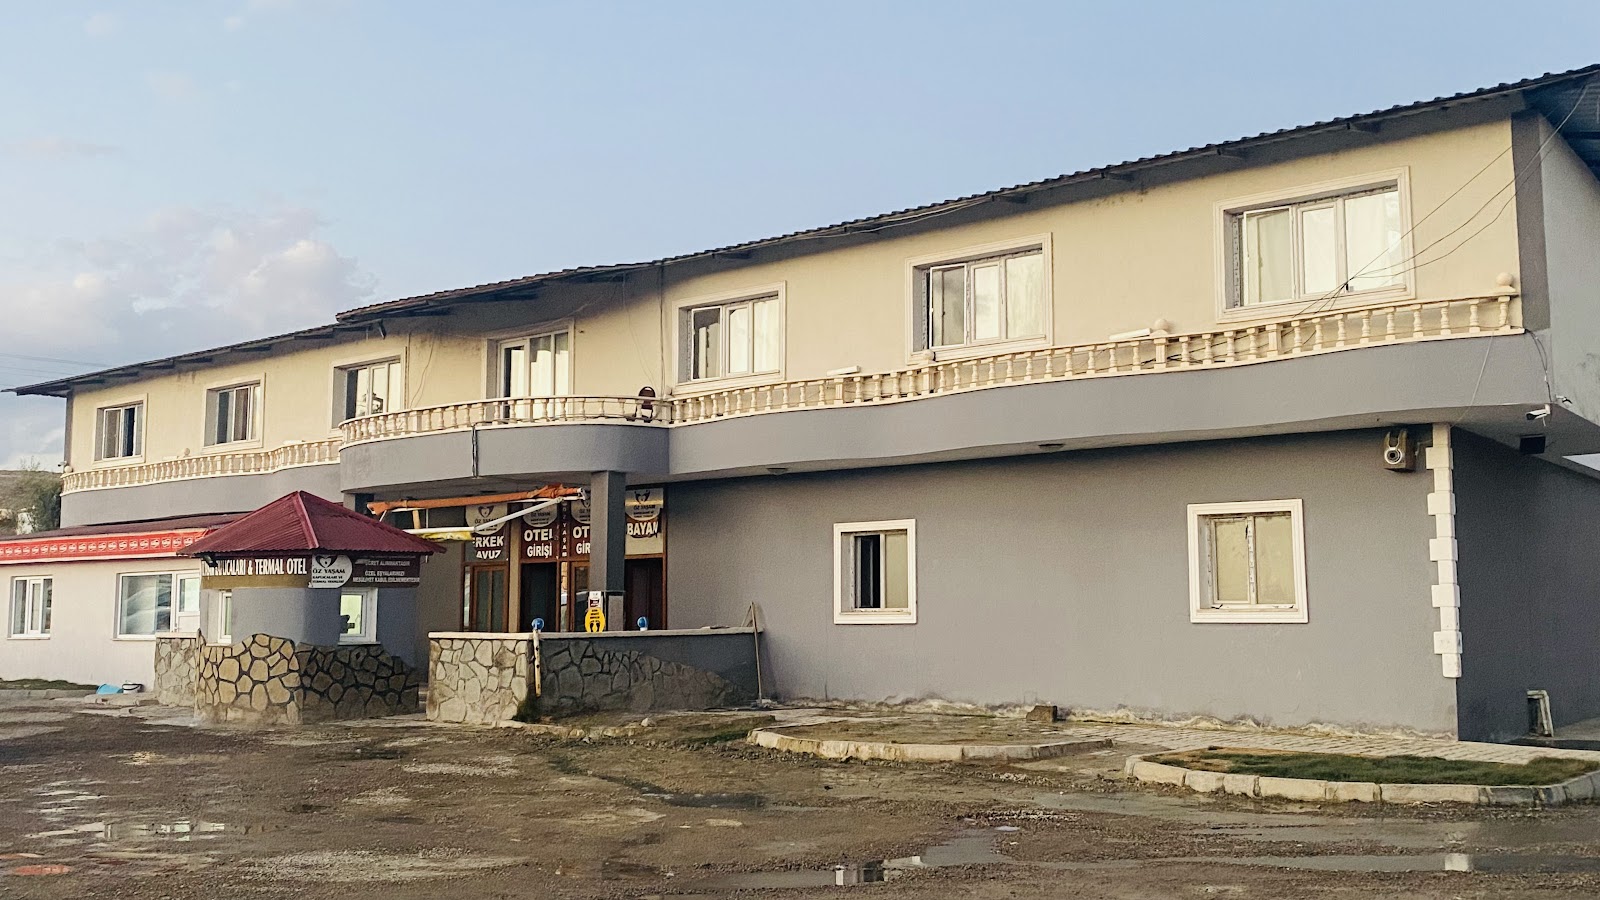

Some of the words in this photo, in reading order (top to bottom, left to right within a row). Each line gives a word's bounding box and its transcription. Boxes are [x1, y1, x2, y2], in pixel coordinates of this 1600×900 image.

[572, 525, 590, 539] OT
[576, 540, 591, 554] GİR
[247, 559, 253, 576] &
[254, 558, 285, 575] TERMAL
[286, 557, 308, 575] OTEL
